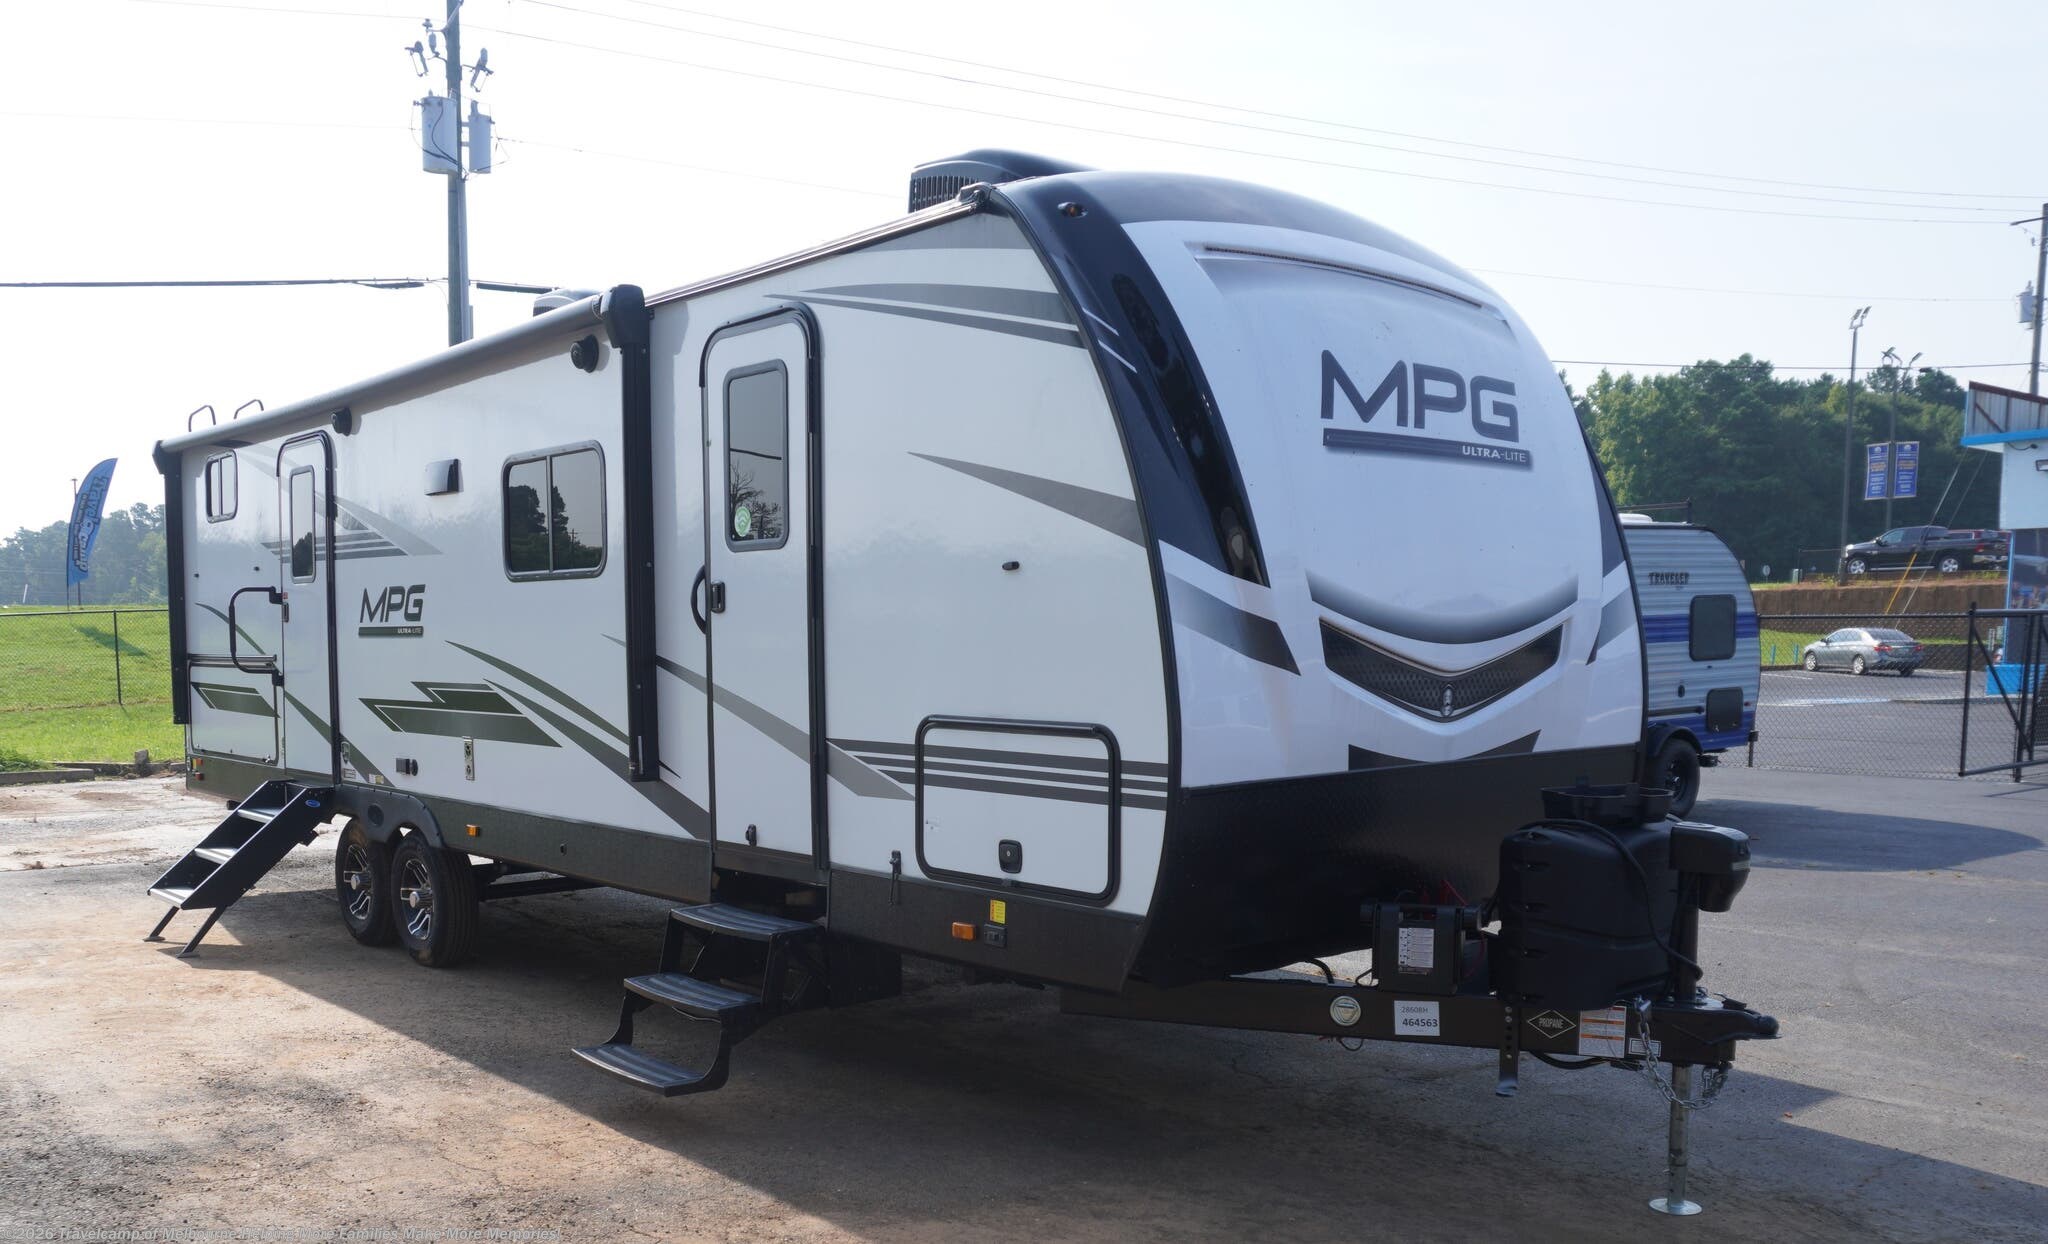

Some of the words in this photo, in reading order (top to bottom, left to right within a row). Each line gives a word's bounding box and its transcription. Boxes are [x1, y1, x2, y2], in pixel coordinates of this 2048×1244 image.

[1321, 350, 1519, 443] MPG
[1462, 445, 1527, 463] ULTRA-LITE
[360, 584, 426, 623] MPG
[1402, 1018, 1438, 1027] 464563
[1538, 1017, 1564, 1029] PROPANE
